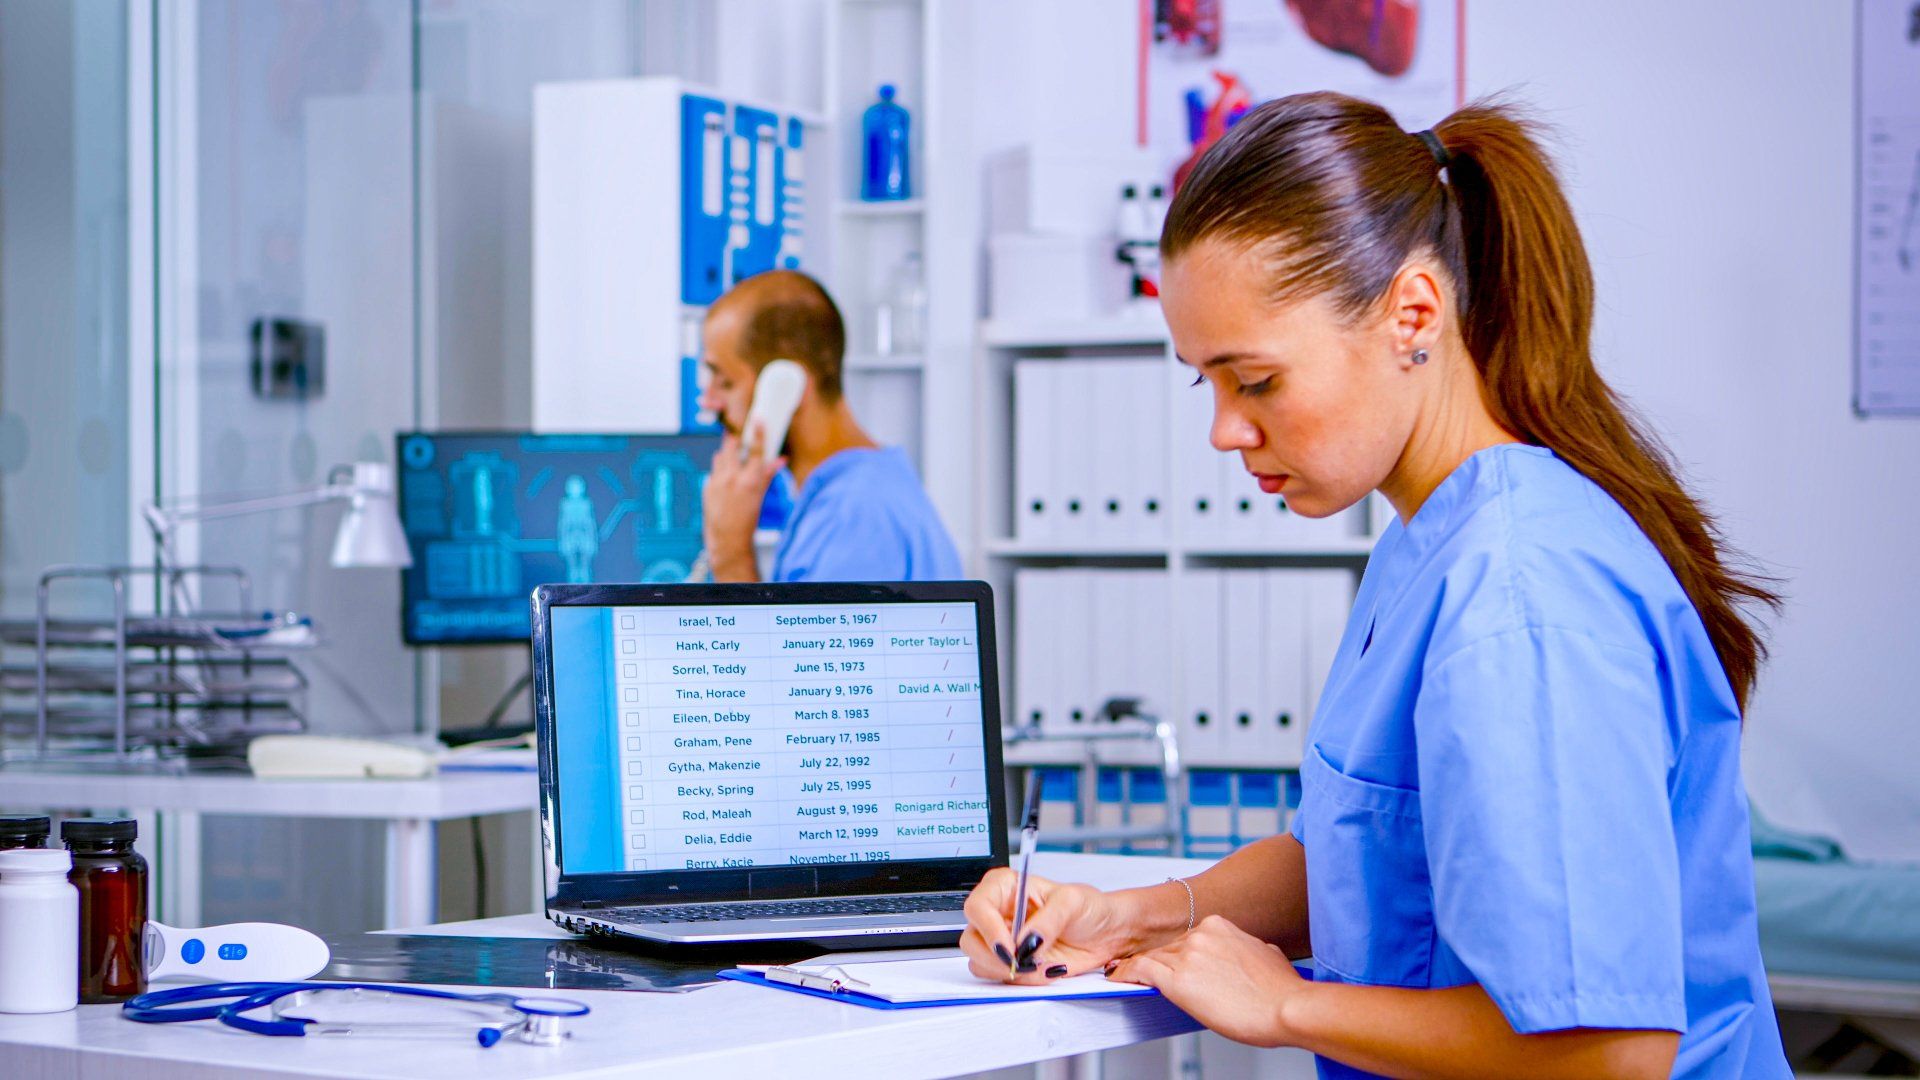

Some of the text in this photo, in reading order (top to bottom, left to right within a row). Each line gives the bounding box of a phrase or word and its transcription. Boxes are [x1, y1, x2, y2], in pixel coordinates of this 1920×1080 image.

[679, 616, 735, 627] Israel, Ted
[776, 614, 877, 626] September 5, 1967
[676, 640, 740, 652] Hank, Carly
[782, 638, 874, 650] January 22, 1969
[891, 637, 972, 648] Porter Taylor L.
[672, 664, 746, 675] Sorrel, Teddy
[794, 662, 865, 673] June 15, 1973
[676, 689, 745, 699] Tina, Horace
[788, 685, 873, 697] January 9, 1976
[899, 684, 929, 694] David
[933, 684, 943, 693] A.
[947, 683, 970, 692] Wall
[673, 711, 750, 724] Eileen, Debby
[795, 710, 829, 720] March
[844, 709, 869, 718] 1983
[674, 736, 752, 747] Graham, Pene
[786, 732, 880, 745] February 17, 1985
[668, 760, 760, 774] Gytha, Makenzie
[800, 756, 870, 769] July 22, 1992
[678, 785, 754, 797] Becky, Spring
[801, 780, 871, 793] July 25, 1995
[796, 803, 878, 817] August 9, 1996
[895, 801, 944, 813] Ronigard
[683, 808, 751, 821] Rod, Maleah
[799, 826, 879, 840] March 12, 1999
[897, 825, 935, 836] Kavieff
[938, 824, 974, 834] Robert
[685, 833, 752, 845] Delia, Eddie
[723, 856, 753, 867] Kacie
[789, 854, 848, 865] November
[865, 851, 890, 862] 1995
